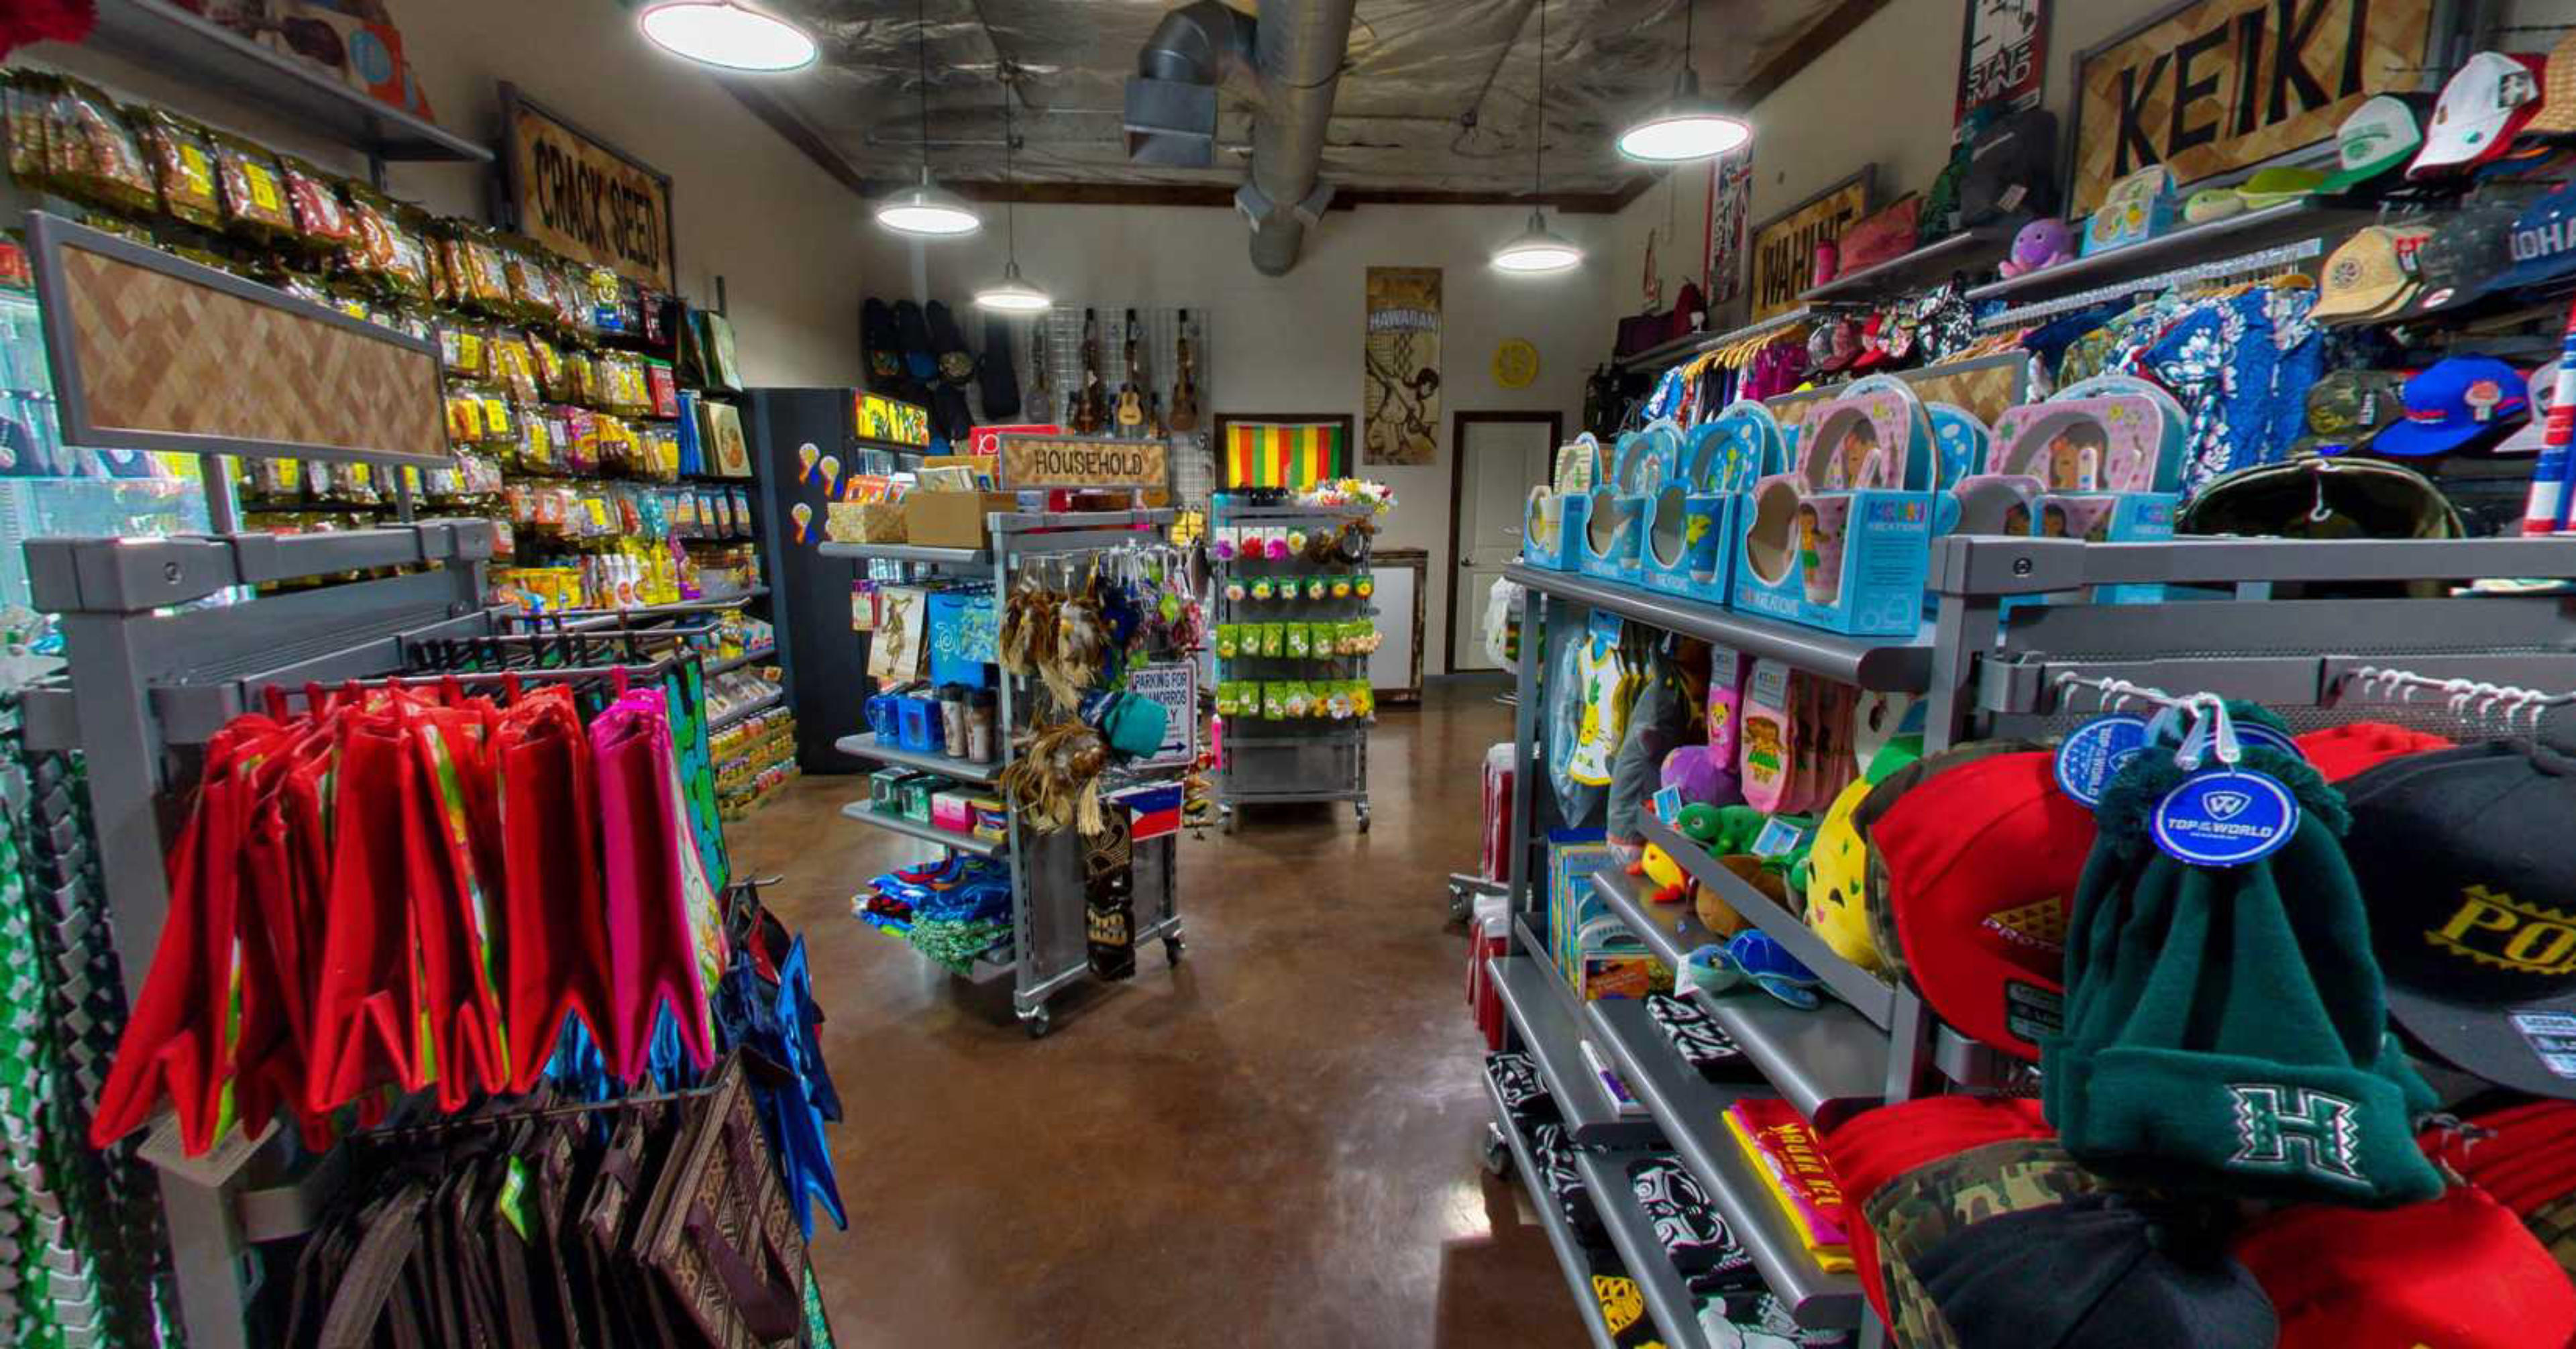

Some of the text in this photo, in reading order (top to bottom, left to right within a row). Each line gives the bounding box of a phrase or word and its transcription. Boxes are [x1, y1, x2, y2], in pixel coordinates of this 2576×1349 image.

[1968, 39, 2034, 89] STATE
[2113, 0, 2375, 180] KEIKI
[533, 136, 659, 274] CRACK SEED
[1035, 448, 1142, 476] HOUSEHOLD
[1134, 672, 1187, 688] PARKING FOR
[2167, 818, 2198, 830] TOP
[2212, 822, 2274, 838] WORLD
